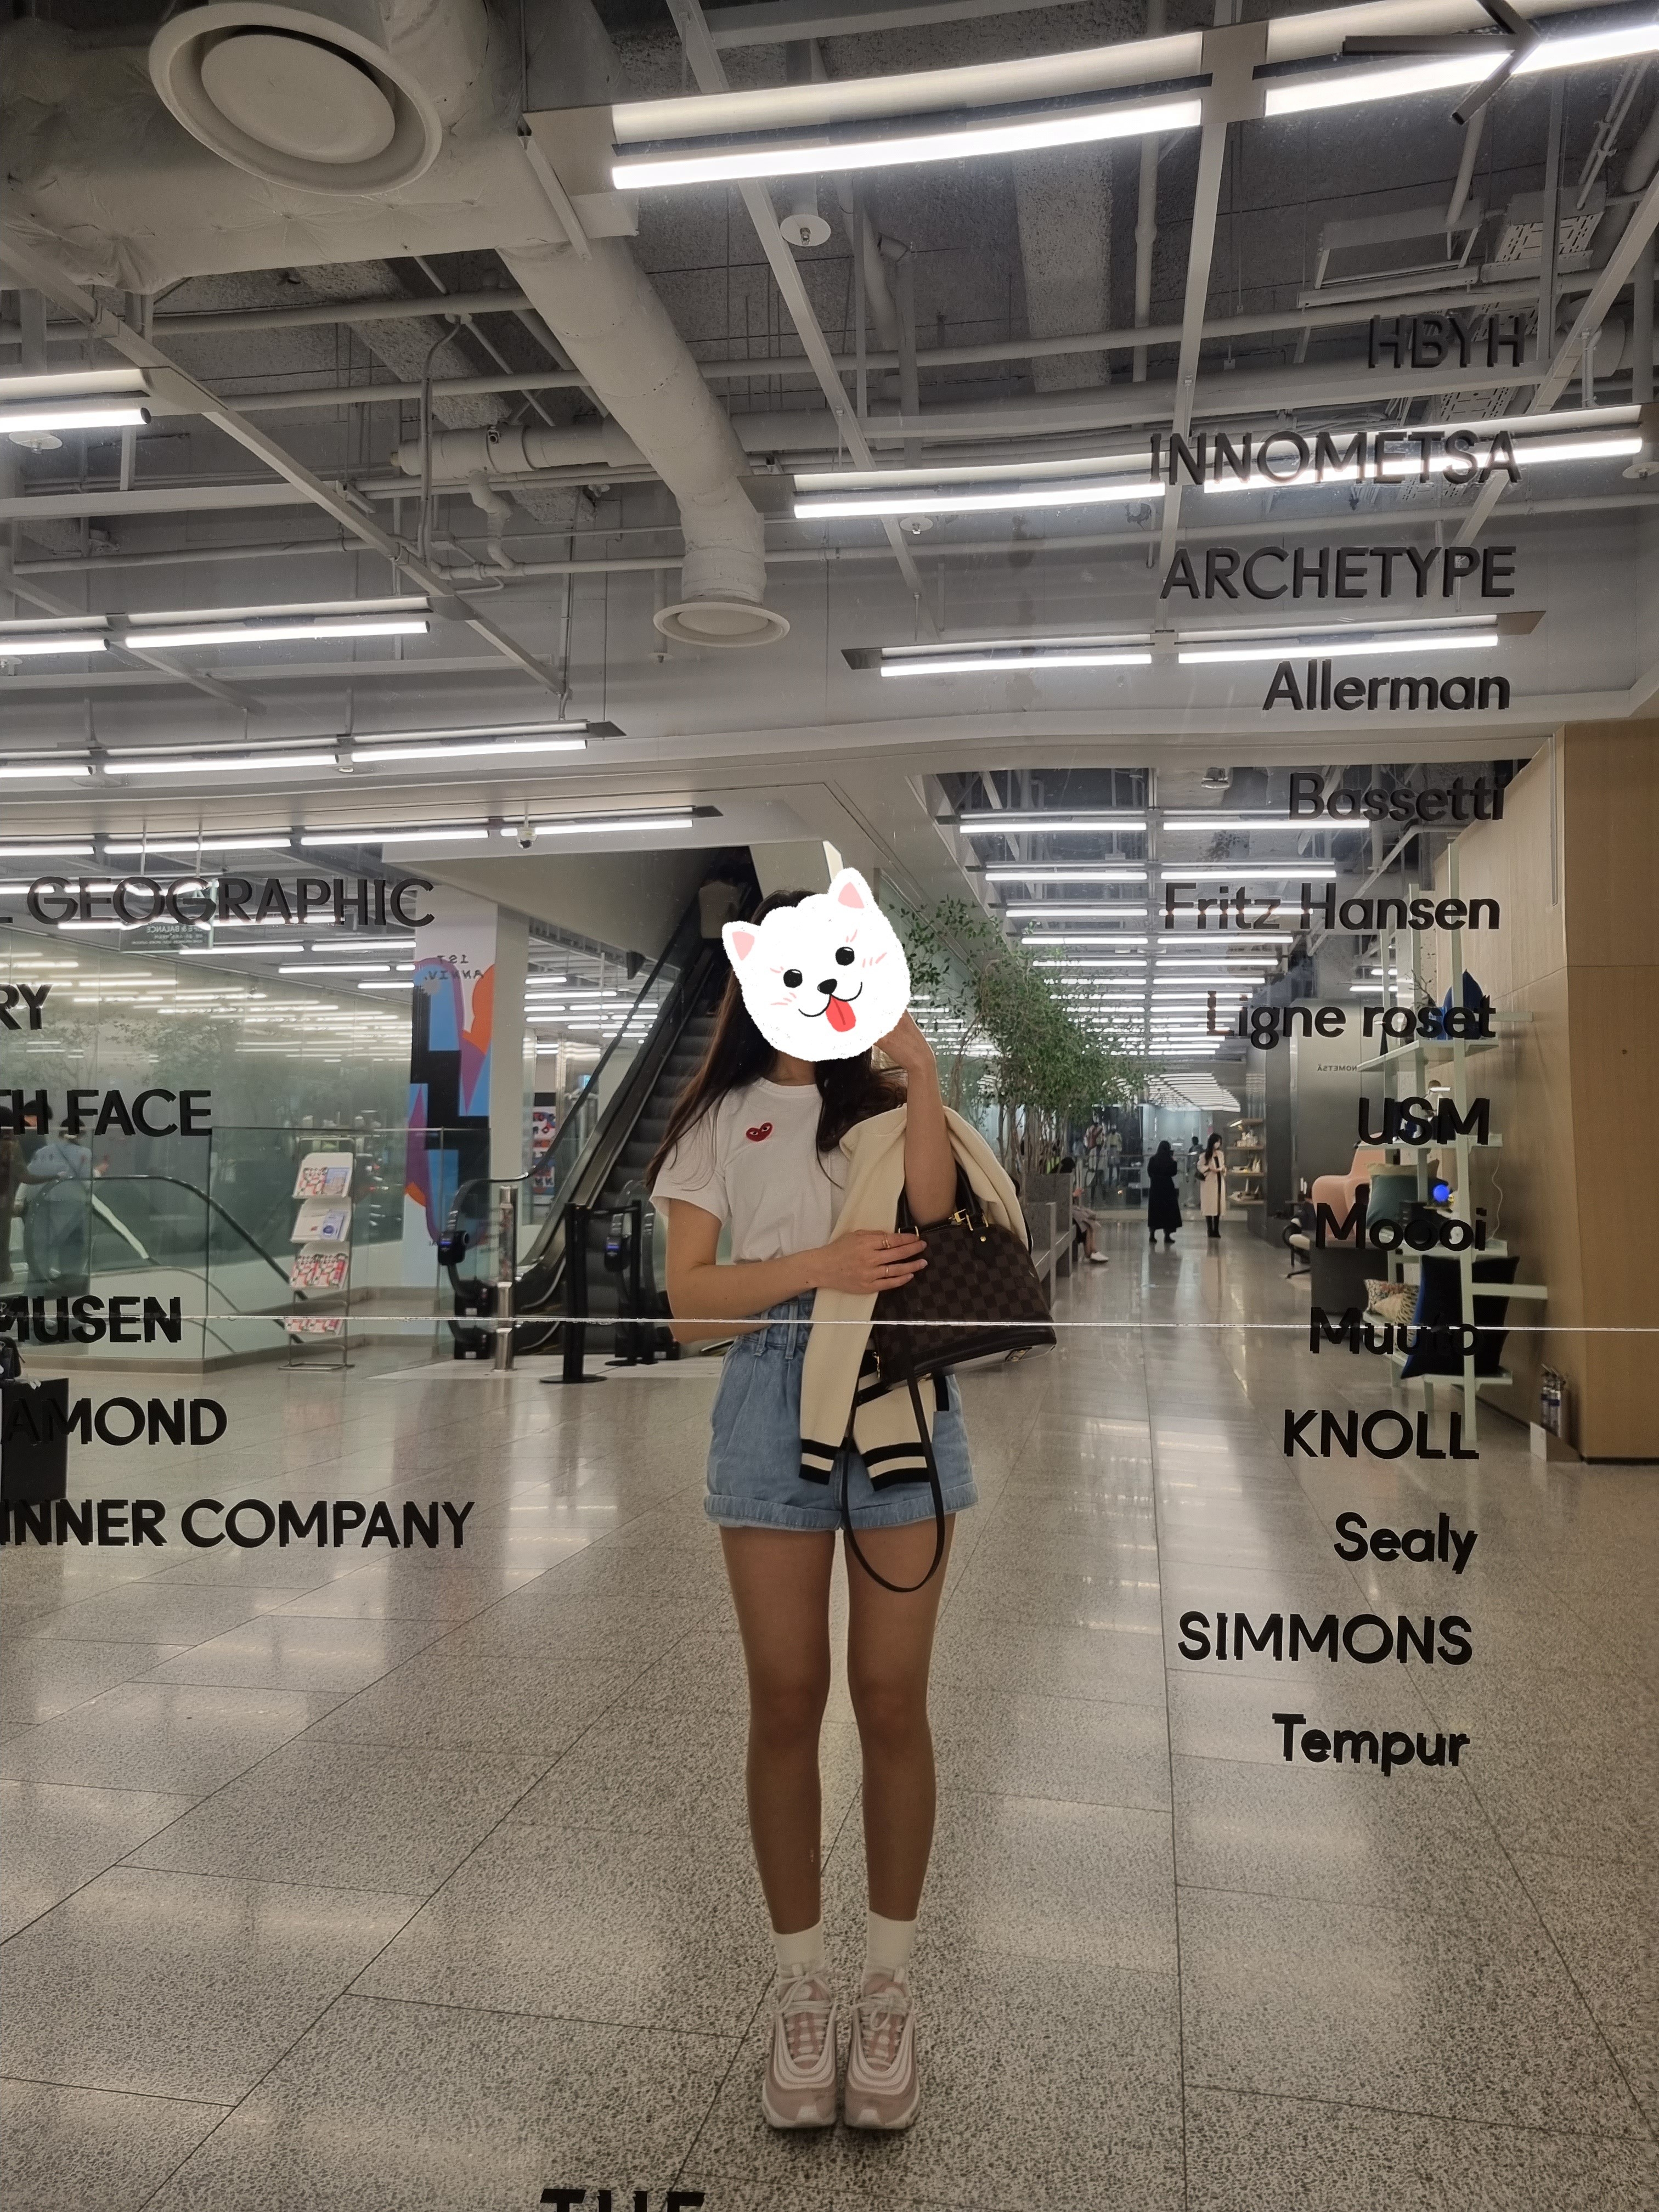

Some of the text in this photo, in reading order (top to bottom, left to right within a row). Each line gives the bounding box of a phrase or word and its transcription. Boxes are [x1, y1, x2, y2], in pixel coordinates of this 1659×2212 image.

[1368, 313, 1526, 369] HBYH
[1150, 430, 1522, 485] INNOMETSA
[1160, 546, 1516, 599] ARCHETYPE
[1262, 660, 1510, 710] Allerman
[1289, 771, 1506, 821] Bassetti
[27, 877, 435, 928] GEOGRAPHIC
[1164, 882, 1500, 930] Fritz Hansen
[1207, 990, 1496, 1050] Ligne roset
[67, 1089, 212, 1137] FACE
[1358, 1097, 1489, 1145] USM
[1316, 1203, 1487, 1251] Moooi
[1284, 1409, 1479, 1460] KNOLL
[181, 1499, 475, 1549] COMPANY
[1334, 1512, 1478, 1575] Sealy
[1177, 1611, 1472, 1665] SIMMONS
[1272, 1713, 1470, 1776] Tempur
